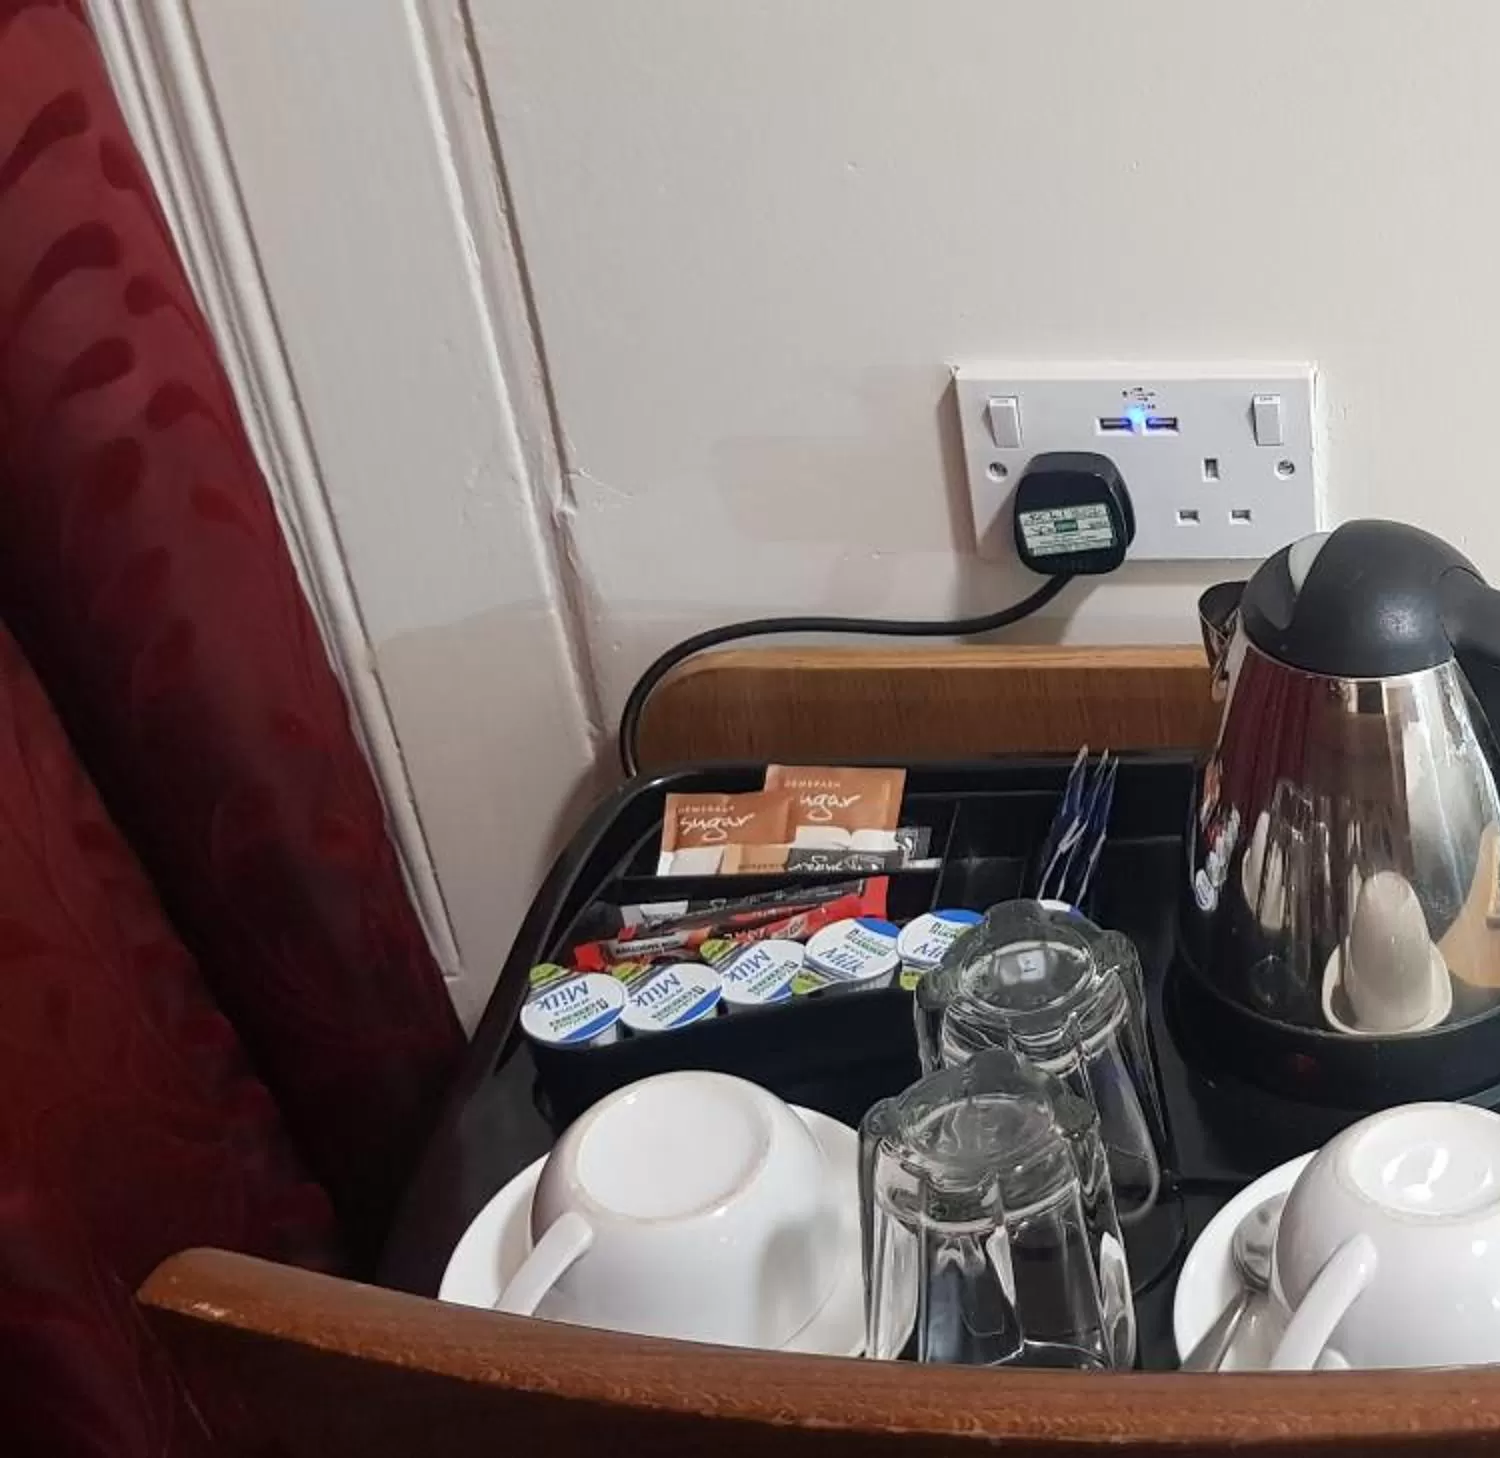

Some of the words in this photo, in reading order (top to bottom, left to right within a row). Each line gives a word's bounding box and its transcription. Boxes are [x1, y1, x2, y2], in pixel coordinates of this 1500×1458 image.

[800, 794, 861, 821] ugar
[680, 812, 755, 842] sugar
[724, 948, 771, 982] Milk
[818, 946, 865, 973] Milk
[537, 981, 590, 1011] Milk
[632, 972, 681, 1008] Milk
